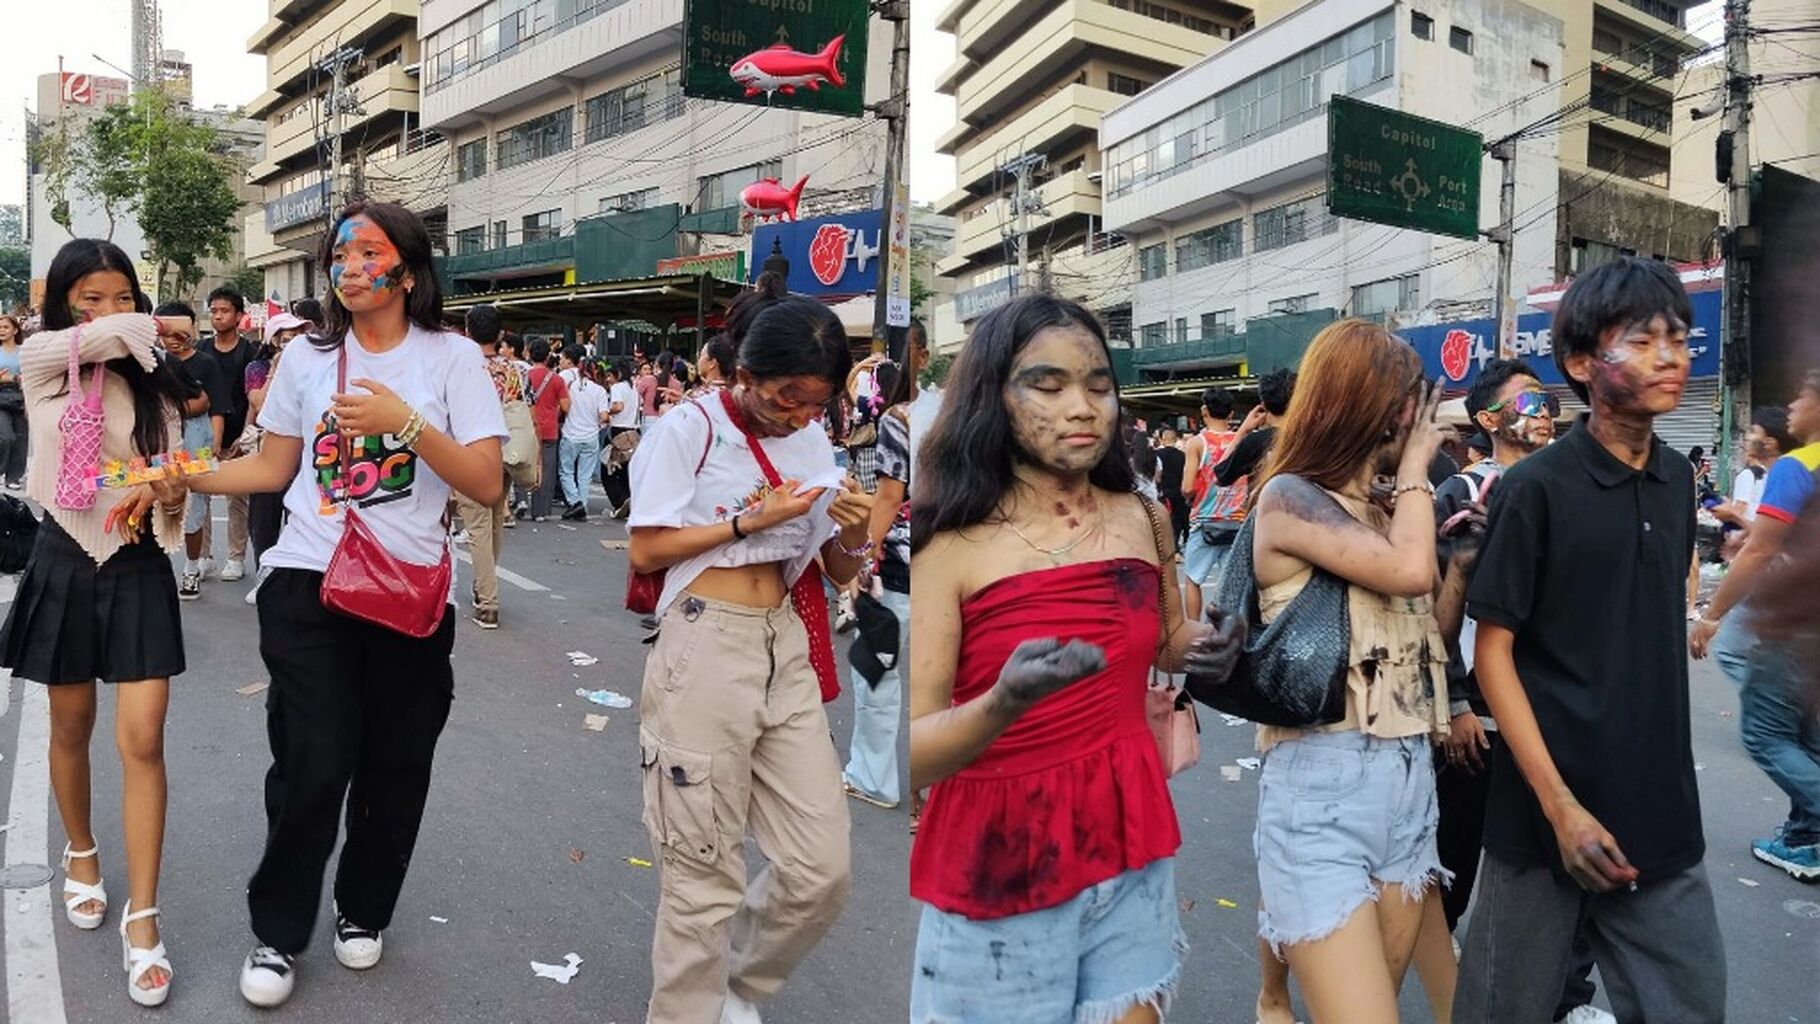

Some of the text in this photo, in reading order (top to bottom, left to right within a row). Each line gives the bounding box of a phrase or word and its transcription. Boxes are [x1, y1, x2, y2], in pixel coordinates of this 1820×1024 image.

[752, 0, 813, 14] apitol
[702, 25, 746, 46] South
[702, 48, 735, 67] Roa
[1381, 123, 1436, 149] Capitol
[1343, 154, 1382, 174] South
[1438, 175, 1468, 194] Port
